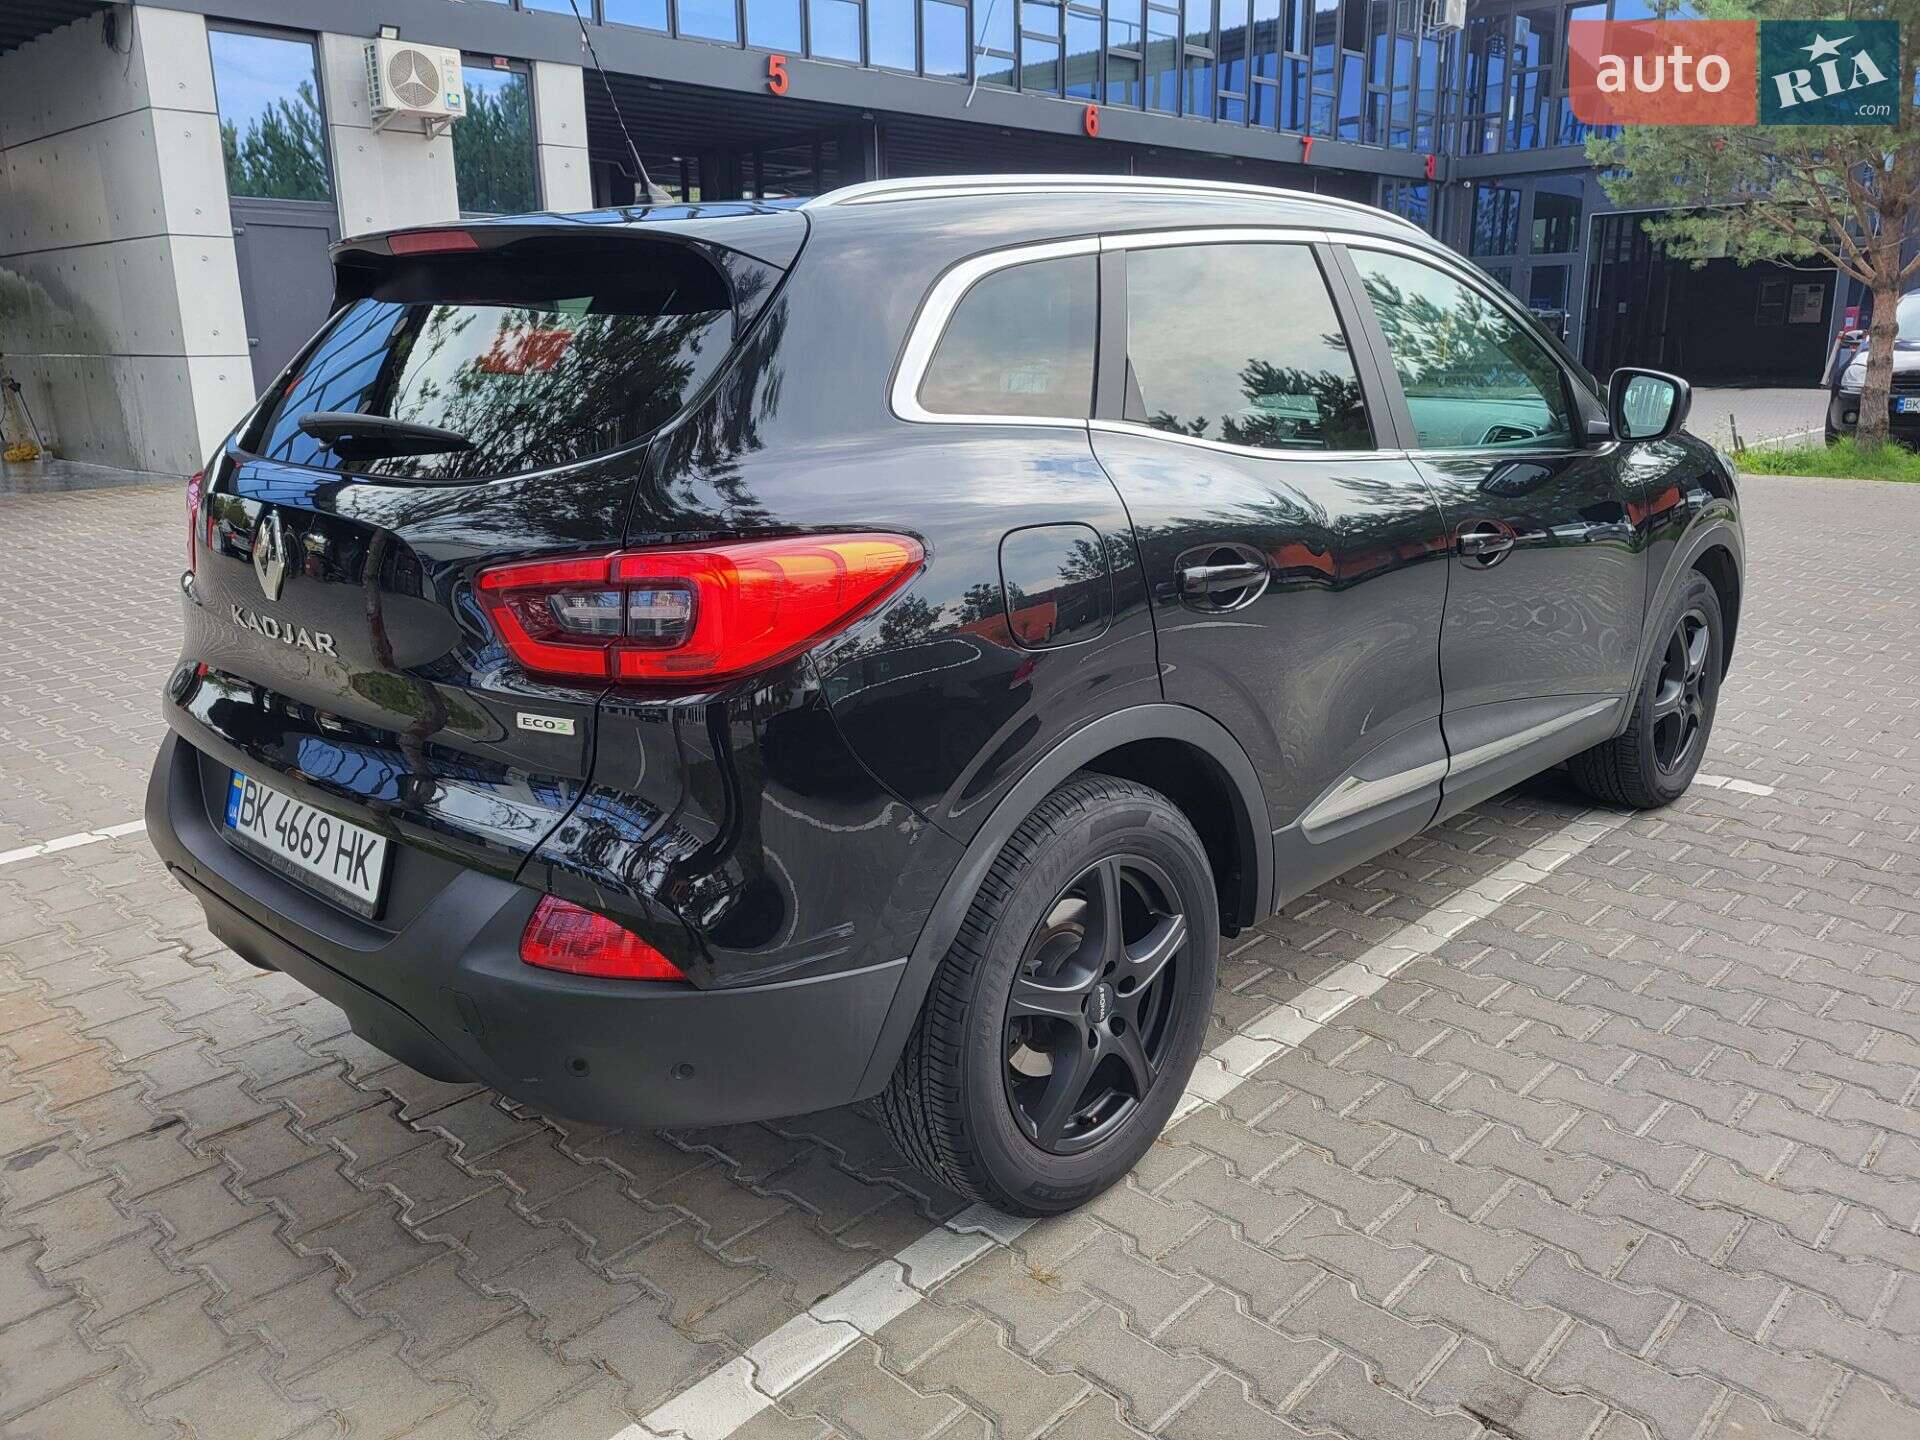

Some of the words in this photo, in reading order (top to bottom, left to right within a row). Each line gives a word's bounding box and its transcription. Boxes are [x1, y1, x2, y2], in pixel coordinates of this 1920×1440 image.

[768, 54, 789, 96] 5
[1083, 103, 1099, 138] 6
[1302, 136, 1313, 165] 7
[1425, 154, 1436, 180] 8
[230, 604, 339, 658] KADJAR
[240, 777, 274, 838] BK
[275, 799, 331, 865] 4669
[333, 824, 377, 891] HK
